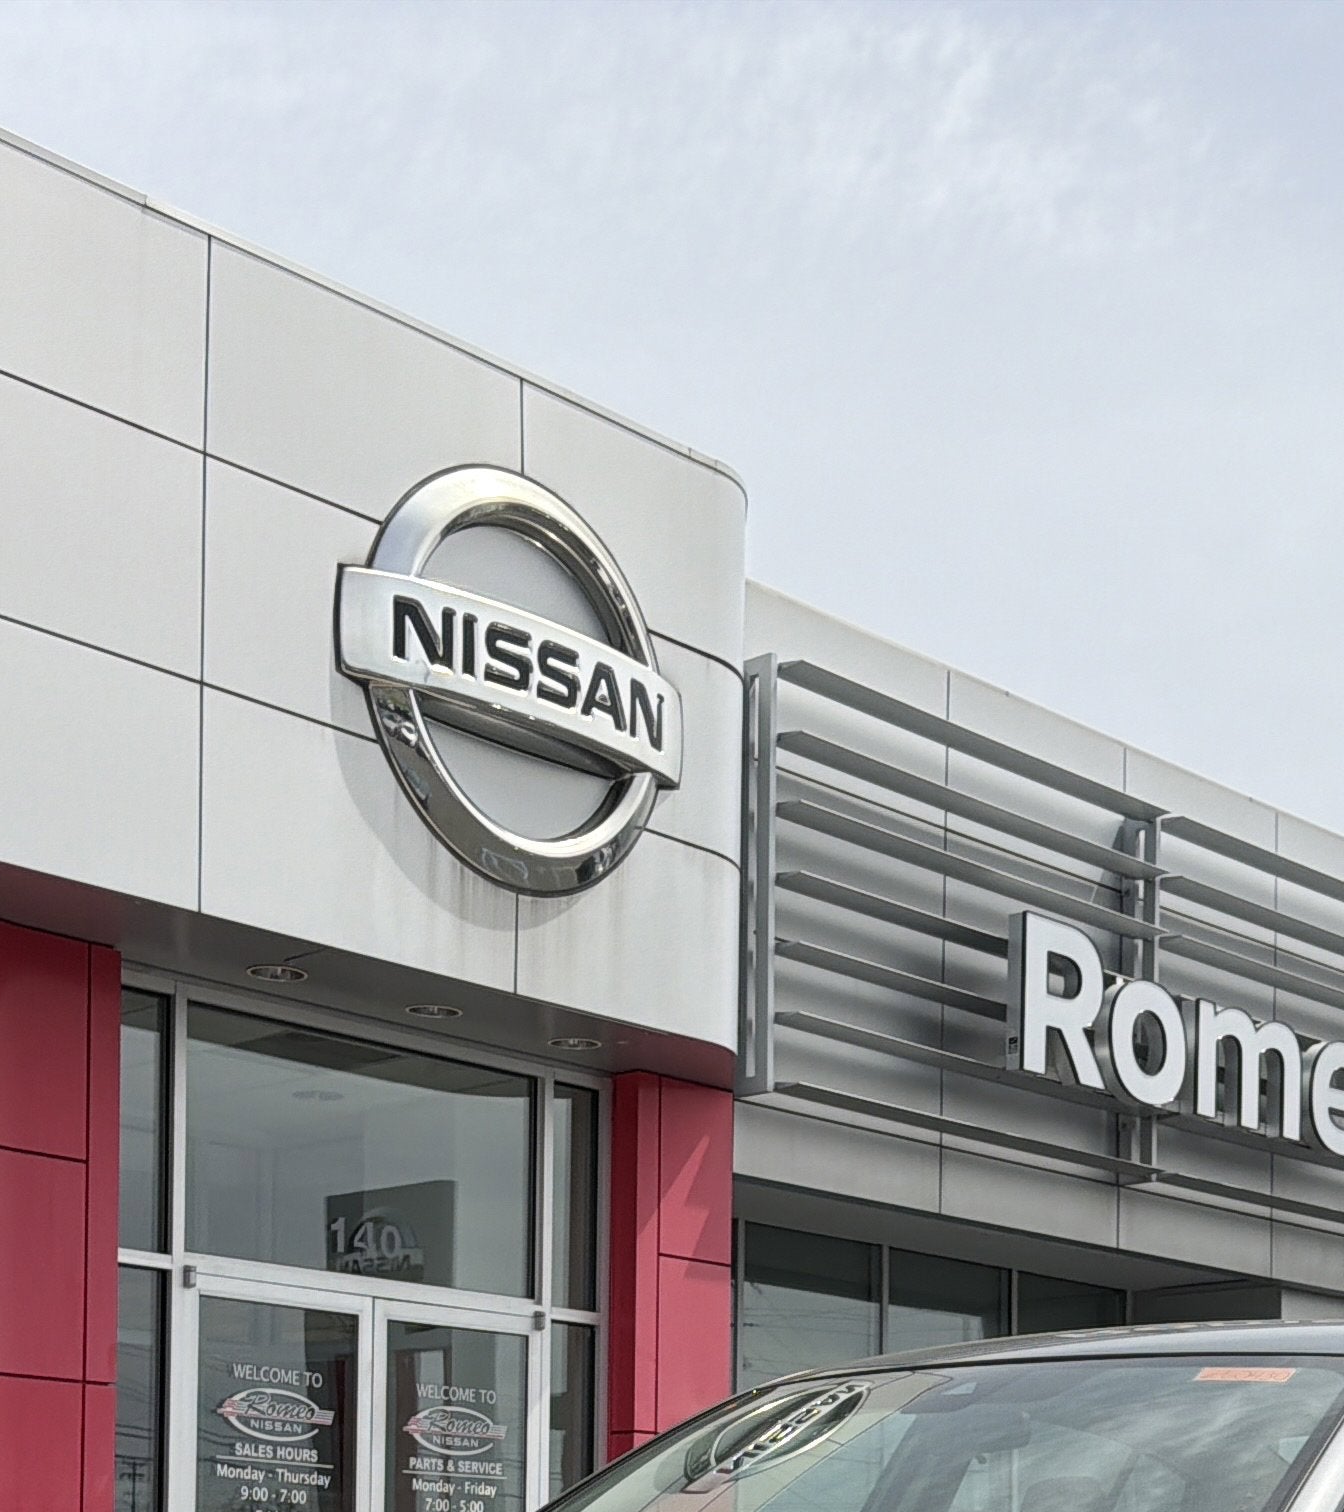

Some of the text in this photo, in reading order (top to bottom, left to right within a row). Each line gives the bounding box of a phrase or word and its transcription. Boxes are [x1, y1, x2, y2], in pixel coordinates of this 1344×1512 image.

[391, 594, 665, 754] NISSAN
[331, 1216, 402, 1259] 140
[232, 1363, 323, 1388] WELCOME TO
[416, 1383, 496, 1405] WELCOME TO
[239, 1391, 316, 1420] Romeo
[250, 1419, 303, 1434] NISSAN
[424, 1409, 491, 1436] Romeo
[432, 1435, 479, 1447] NISSAN
[235, 1442, 318, 1463] SALES HOURS
[216, 1464, 265, 1483] Monday
[276, 1468, 331, 1489] Thursday
[409, 1457, 502, 1475] PARTS & SERVICE
[240, 1485, 268, 1502] 9:00
[279, 1489, 307, 1505] 7:00
[412, 1478, 455, 1496] Monday
[464, 1481, 497, 1498] Friday
[425, 1498, 450, 1512] 7:00
